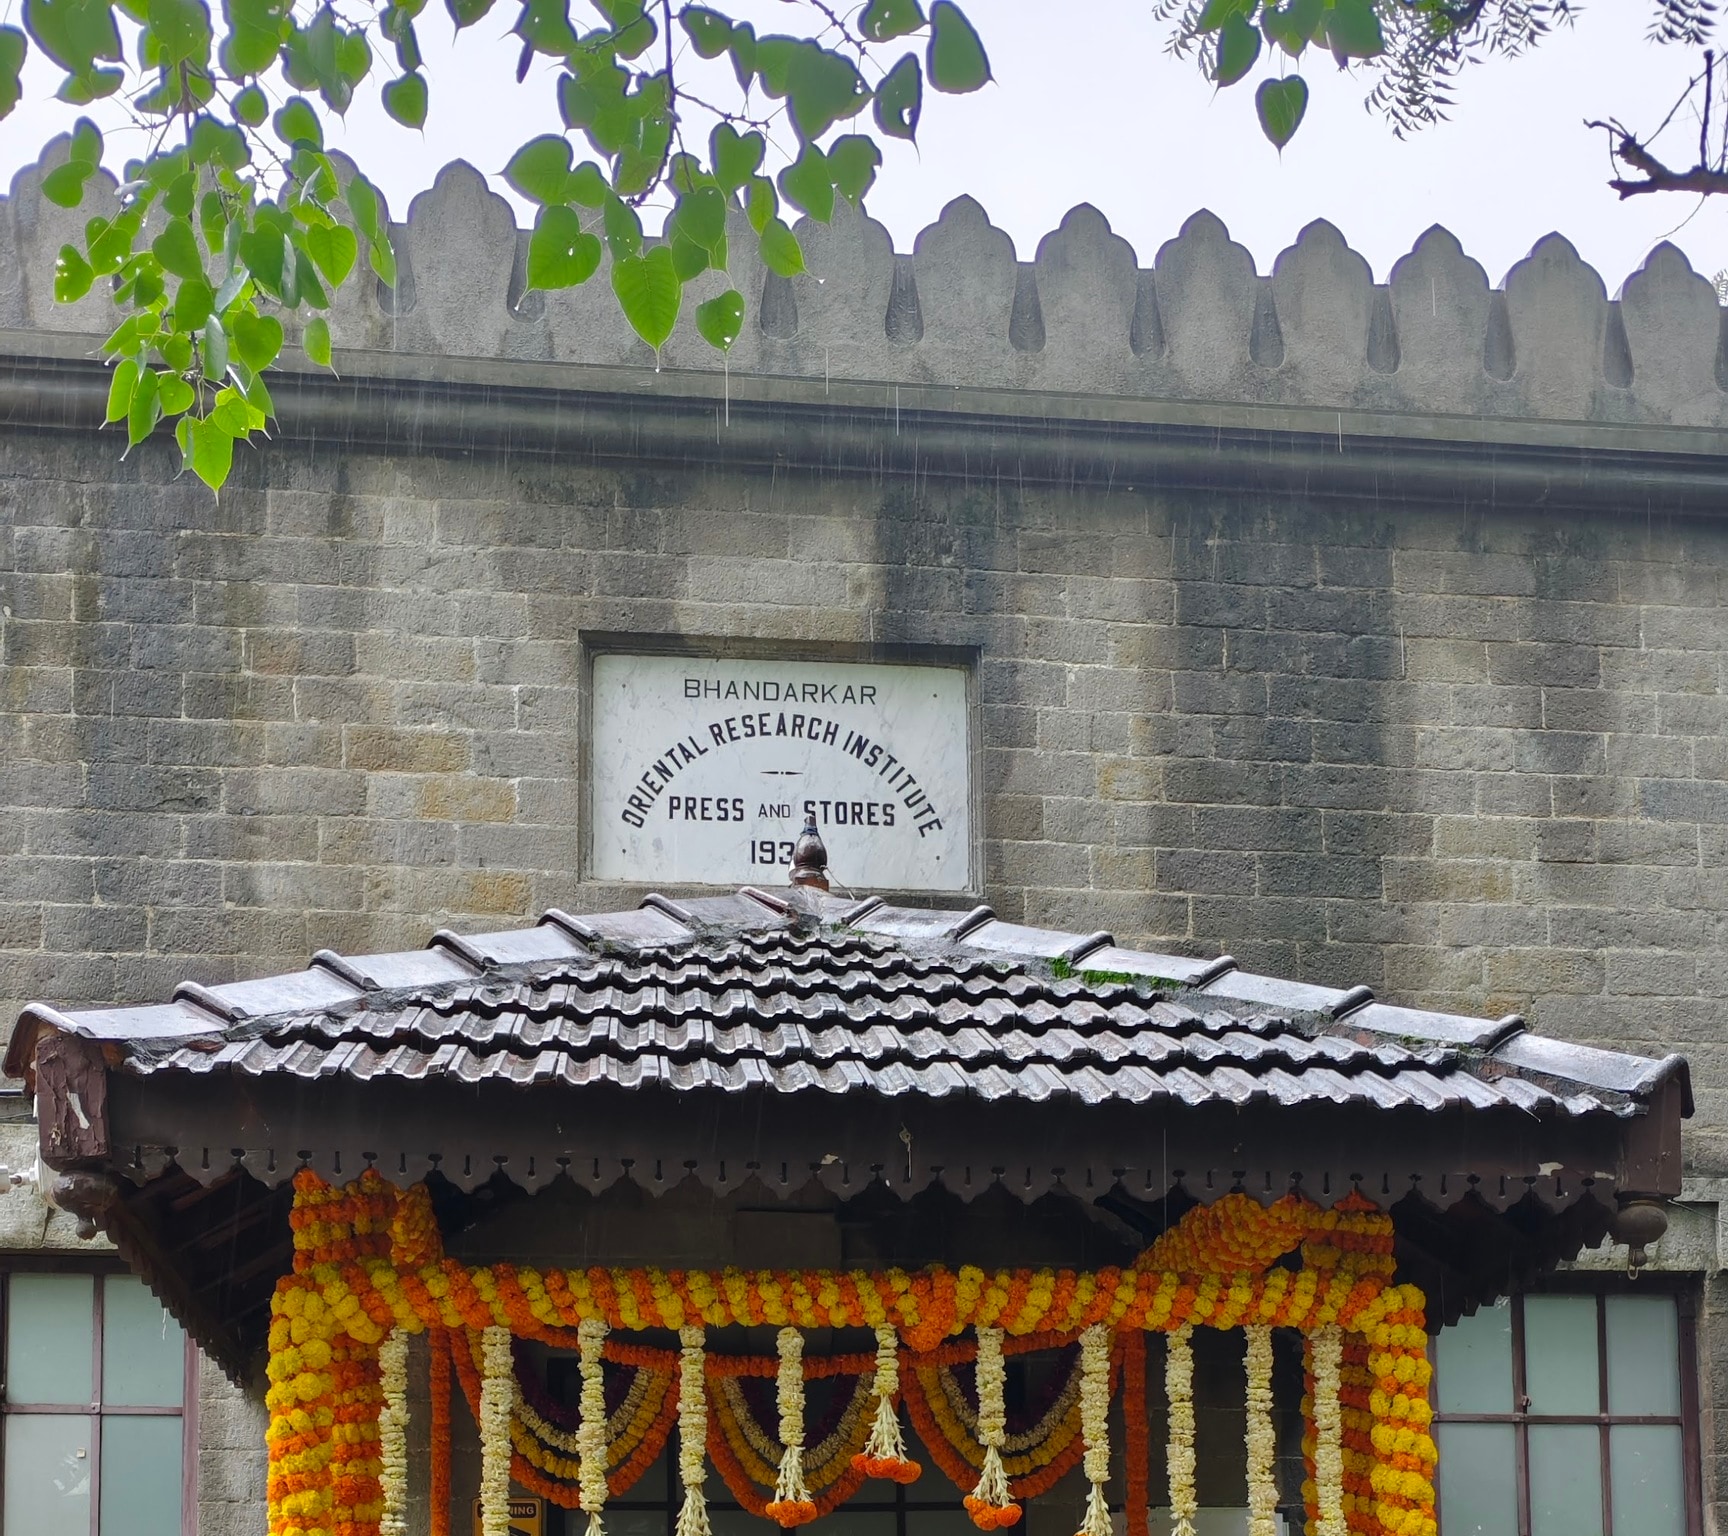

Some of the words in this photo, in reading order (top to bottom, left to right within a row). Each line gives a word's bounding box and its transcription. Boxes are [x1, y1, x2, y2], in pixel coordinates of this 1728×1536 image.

[684, 678, 877, 705] BHANDARKAR
[621, 735, 709, 829] ORIENTAL
[708, 712, 840, 747] RESEARCH
[842, 730, 943, 838] INSTITUTE
[668, 795, 744, 822] PRESS
[758, 803, 791, 819] AND
[803, 800, 895, 827] STORES
[751, 840, 795, 865] 193
